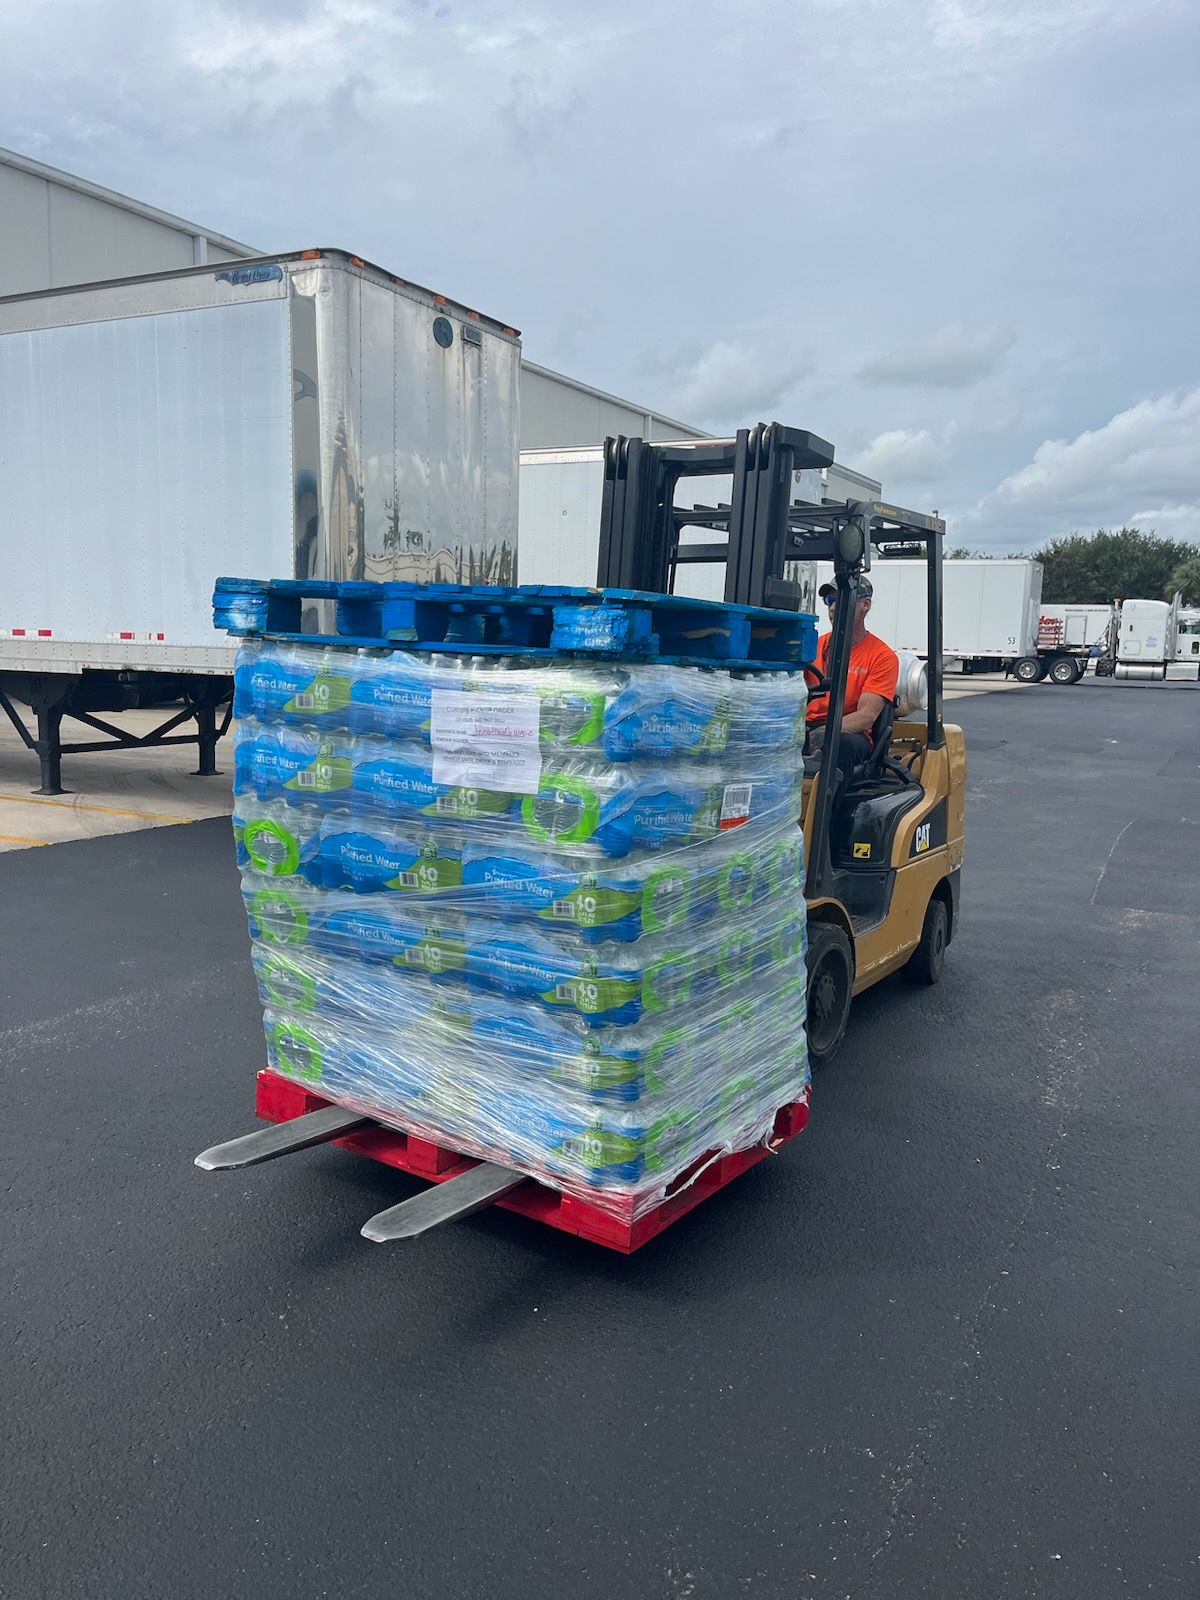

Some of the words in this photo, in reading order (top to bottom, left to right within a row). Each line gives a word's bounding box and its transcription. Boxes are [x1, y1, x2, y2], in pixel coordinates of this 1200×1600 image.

[1007, 636, 1016, 645] 53
[411, 693, 432, 707] Wate
[315, 763, 333, 780] 40
[458, 788, 479, 806] 40
[915, 822, 931, 852] CAT
[419, 864, 438, 882] 40
[525, 881, 555, 898] Water
[576, 894, 597, 913] 40
[423, 943, 441, 960] 40
[578, 981, 599, 1000] 40
